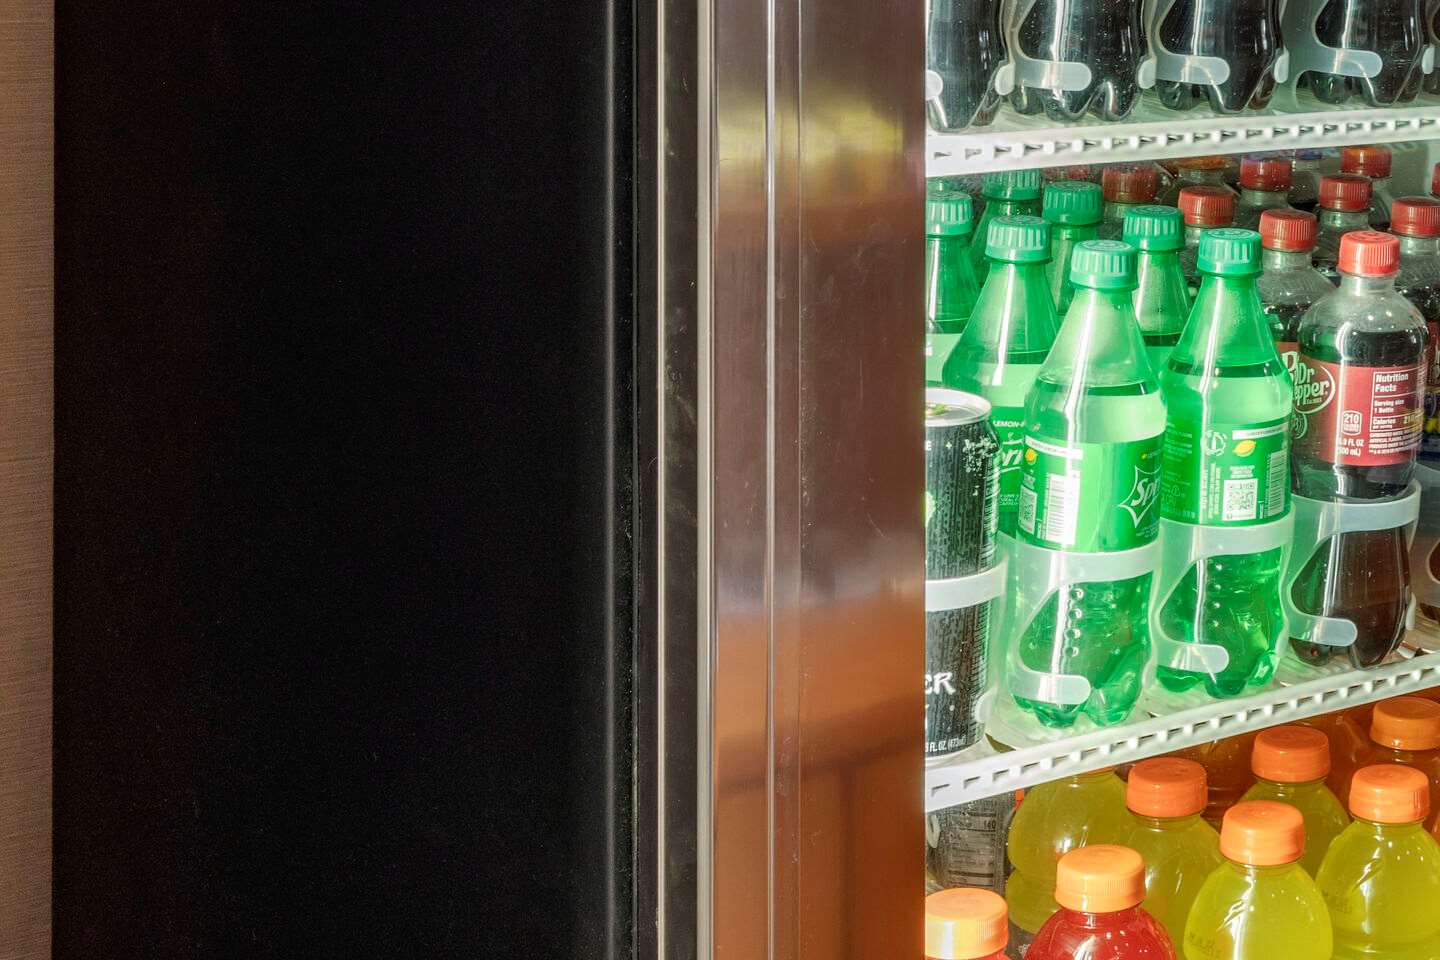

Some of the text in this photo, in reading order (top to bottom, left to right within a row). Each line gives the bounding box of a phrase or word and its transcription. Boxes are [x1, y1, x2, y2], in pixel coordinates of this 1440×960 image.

[1375, 373, 1409, 383] Nutrition
[1375, 384, 1397, 393] Facts
[1344, 413, 1359, 424] 210
[993, 420, 1024, 428] LEMON-
